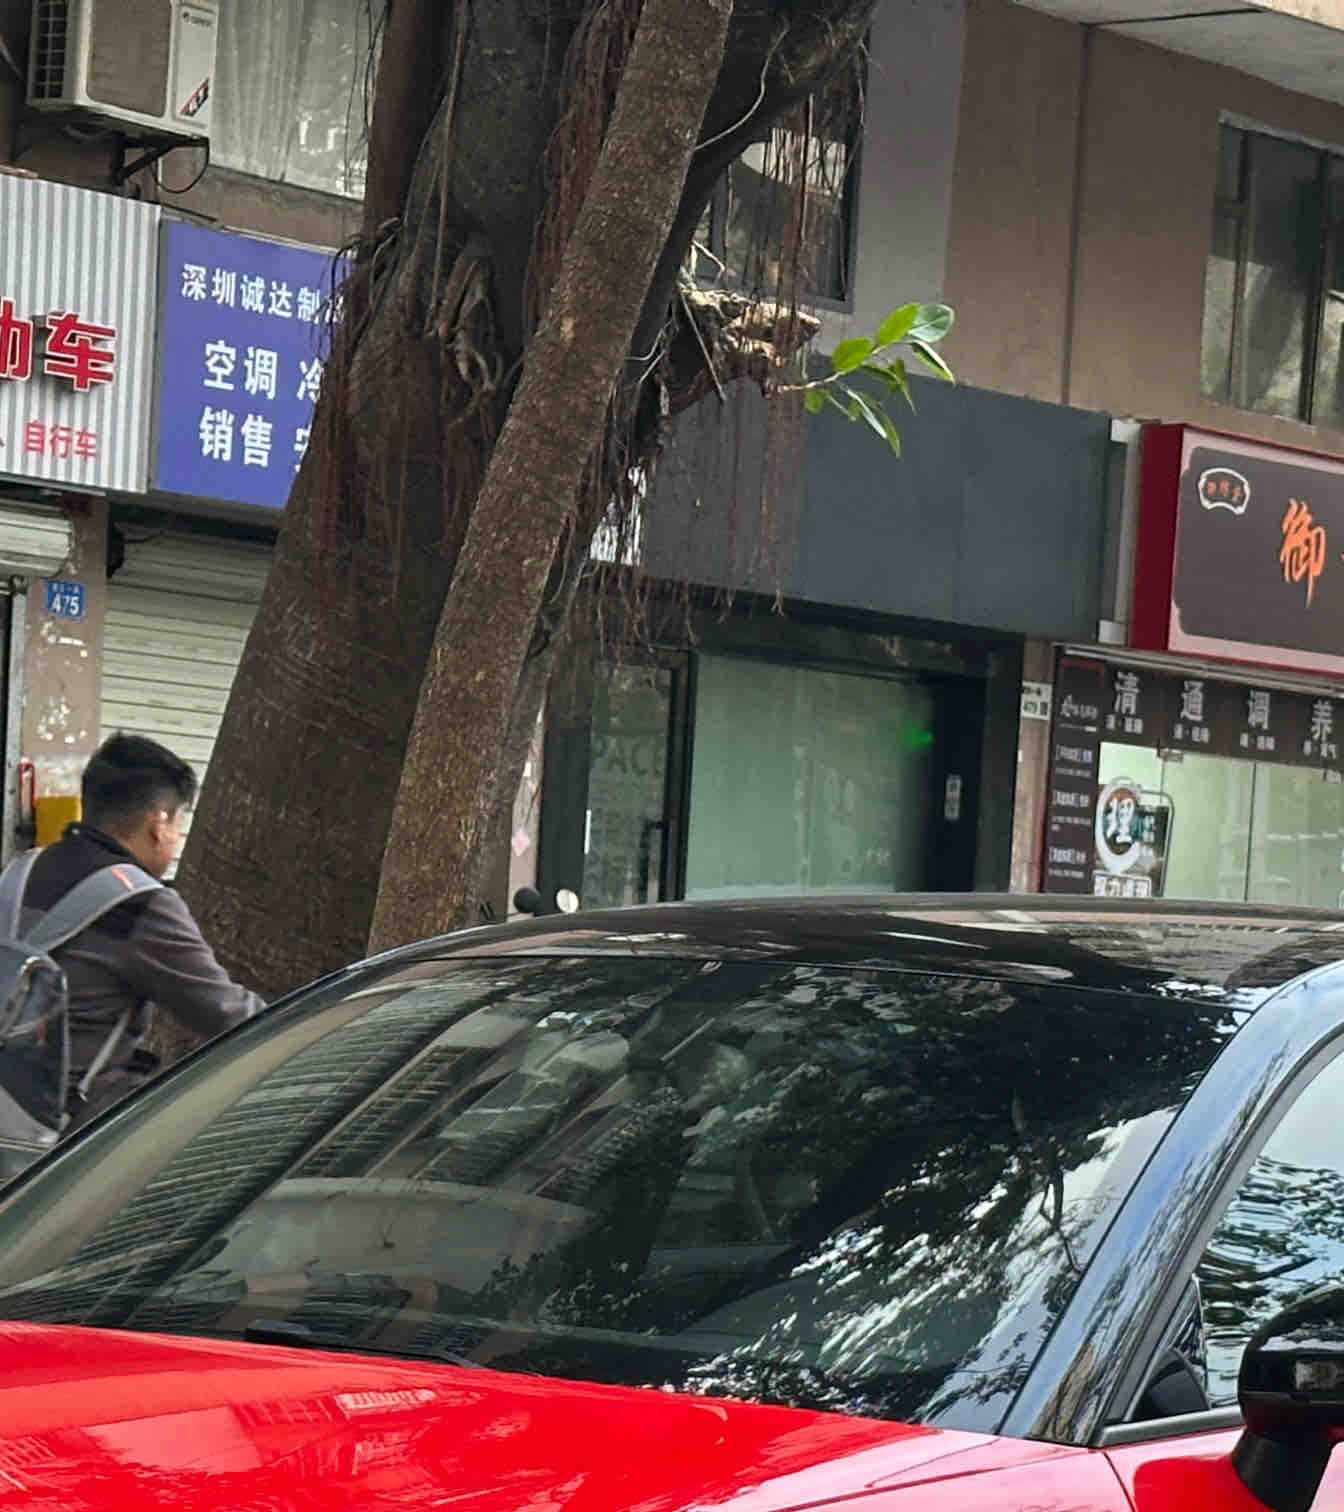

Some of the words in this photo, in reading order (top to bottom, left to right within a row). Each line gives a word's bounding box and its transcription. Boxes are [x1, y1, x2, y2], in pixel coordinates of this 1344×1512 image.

[204, 340, 278, 400] 空调
[199, 406, 272, 467] 销售
[50, 593, 81, 615] 475
